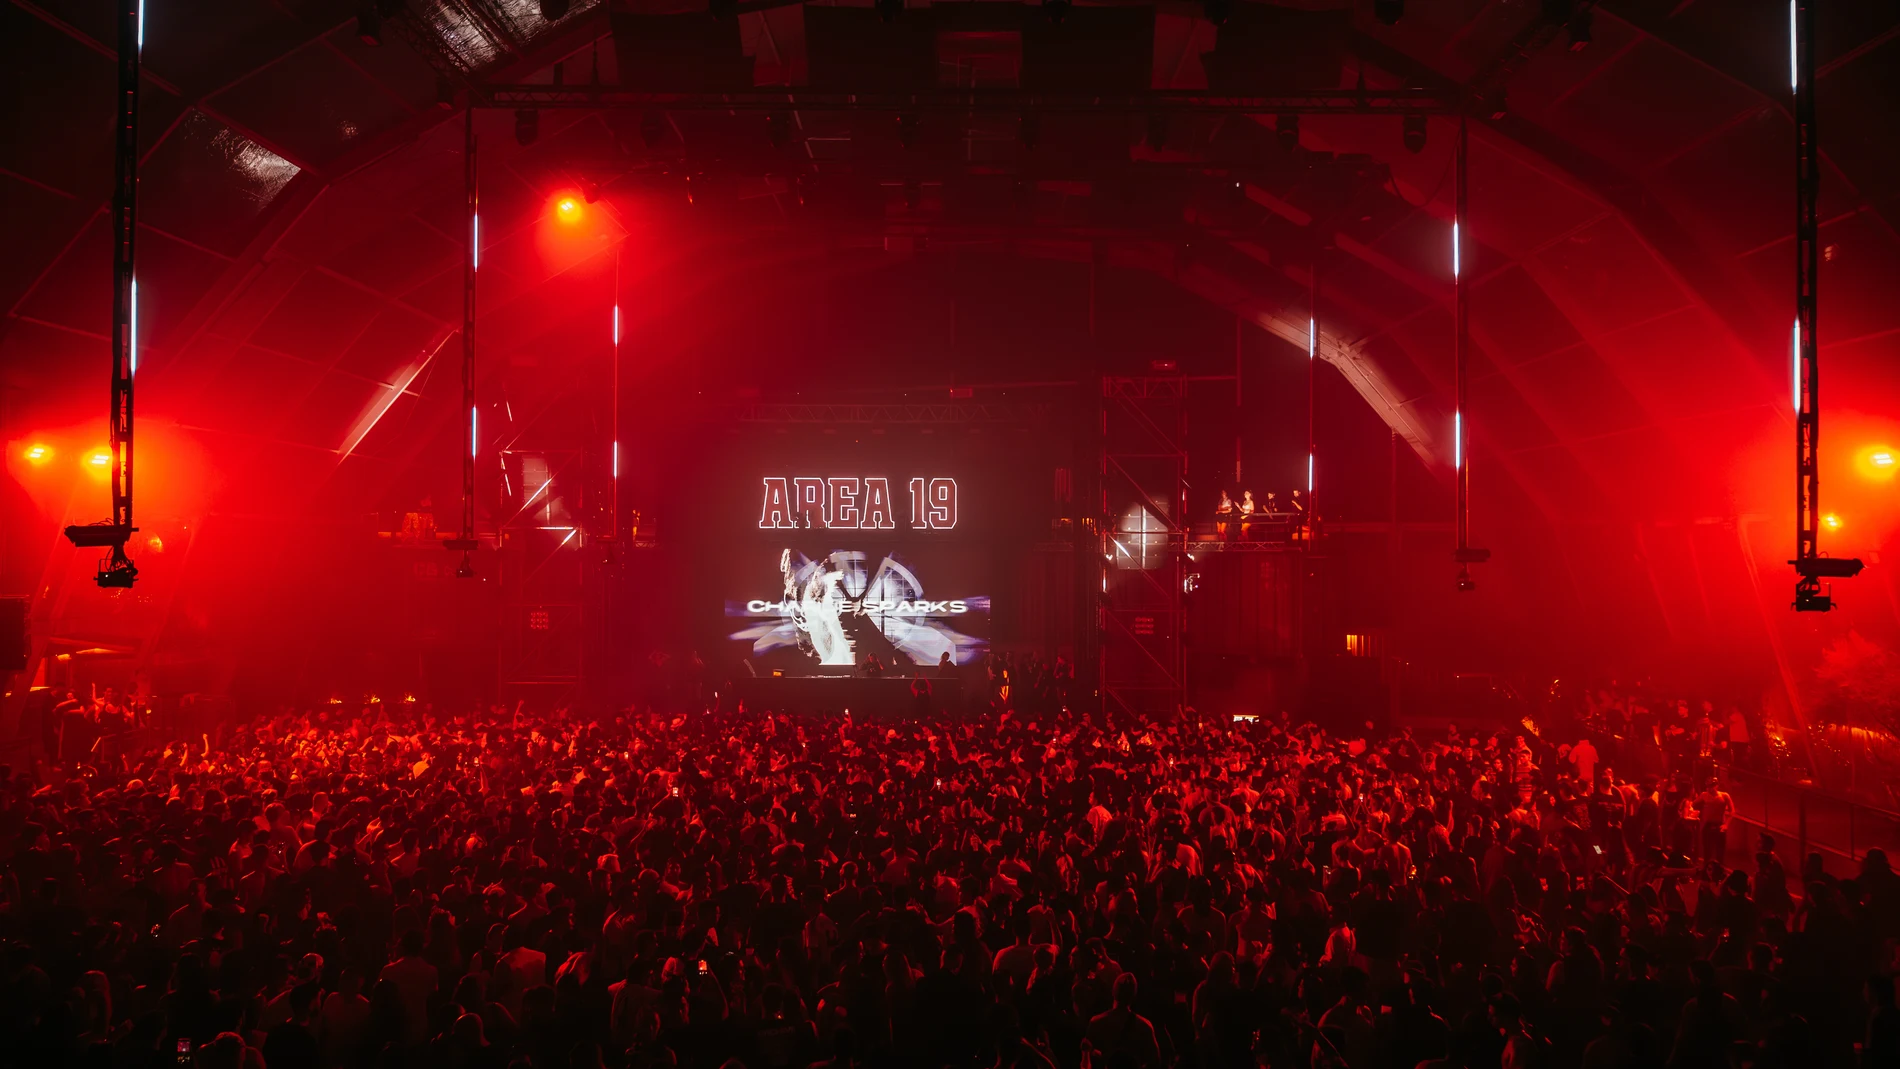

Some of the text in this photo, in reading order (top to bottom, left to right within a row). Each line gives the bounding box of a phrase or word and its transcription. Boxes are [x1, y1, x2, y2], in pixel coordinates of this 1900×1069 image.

[759, 477, 958, 529] AREA 19
[747, 599, 968, 613] CHAE SPARKS
